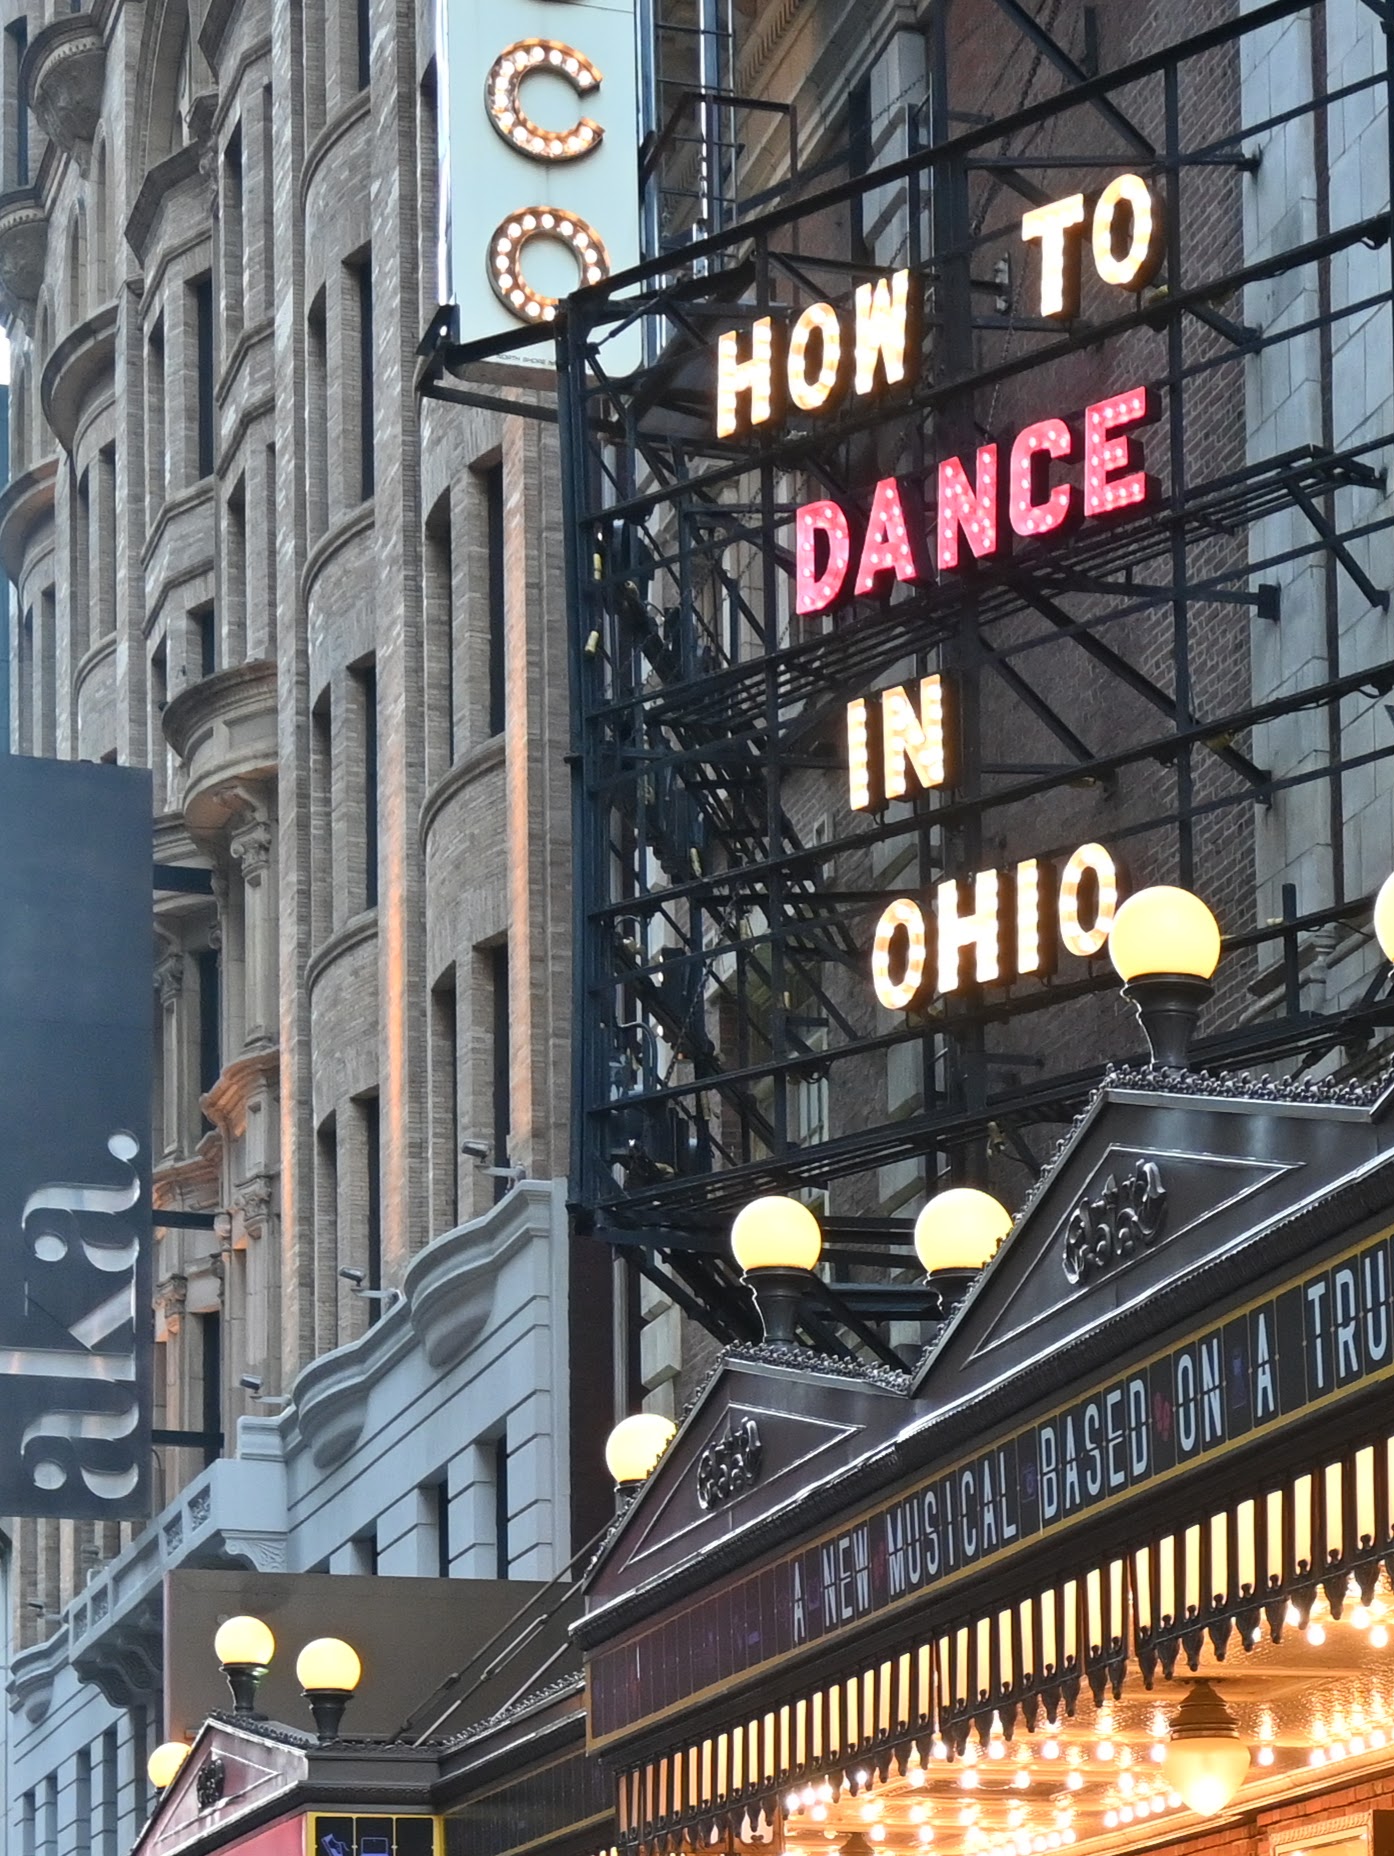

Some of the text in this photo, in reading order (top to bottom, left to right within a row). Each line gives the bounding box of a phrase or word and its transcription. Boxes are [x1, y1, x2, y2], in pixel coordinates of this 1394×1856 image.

[716, 173, 1157, 439] HOW TO
[796, 385, 1148, 615] DANCE
[847, 673, 946, 811] IN
[872, 843, 1118, 1010] OHIO
[0, 1128, 141, 1500] aka.
[793, 1568, 805, 1643] A
[823, 1525, 870, 1632] NEW
[885, 1453, 1017, 1594] MUSICAL
[1040, 1379, 1148, 1531] BASED
[1177, 1338, 1222, 1452] ON
[1256, 1313, 1275, 1418] A
